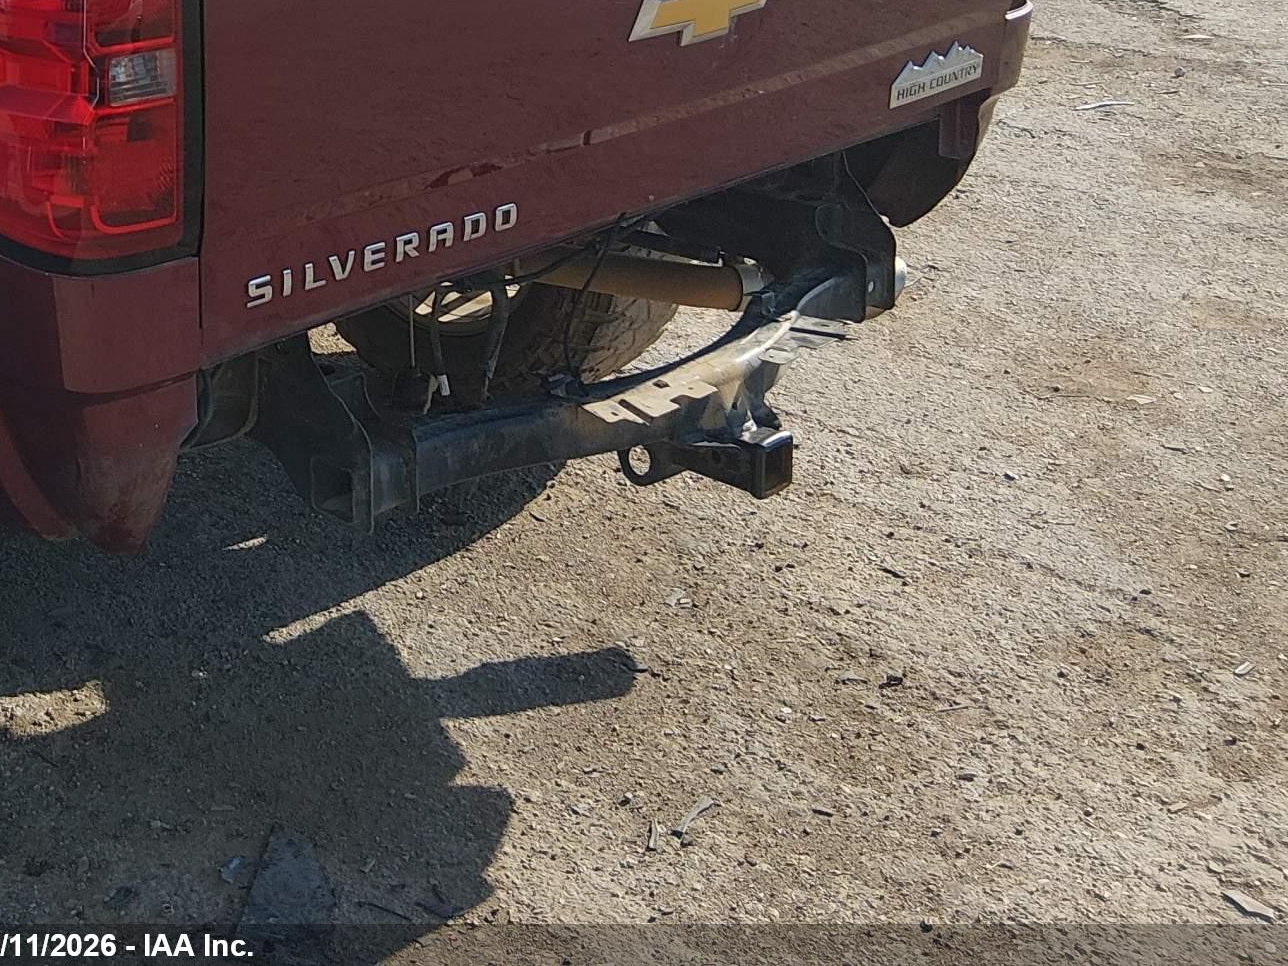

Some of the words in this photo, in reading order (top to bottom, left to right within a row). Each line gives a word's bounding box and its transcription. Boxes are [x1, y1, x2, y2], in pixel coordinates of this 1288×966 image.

[896, 81, 926, 101] HIGH
[929, 63, 978, 90] COUNTRY
[246, 202, 518, 308] SILVERADO
